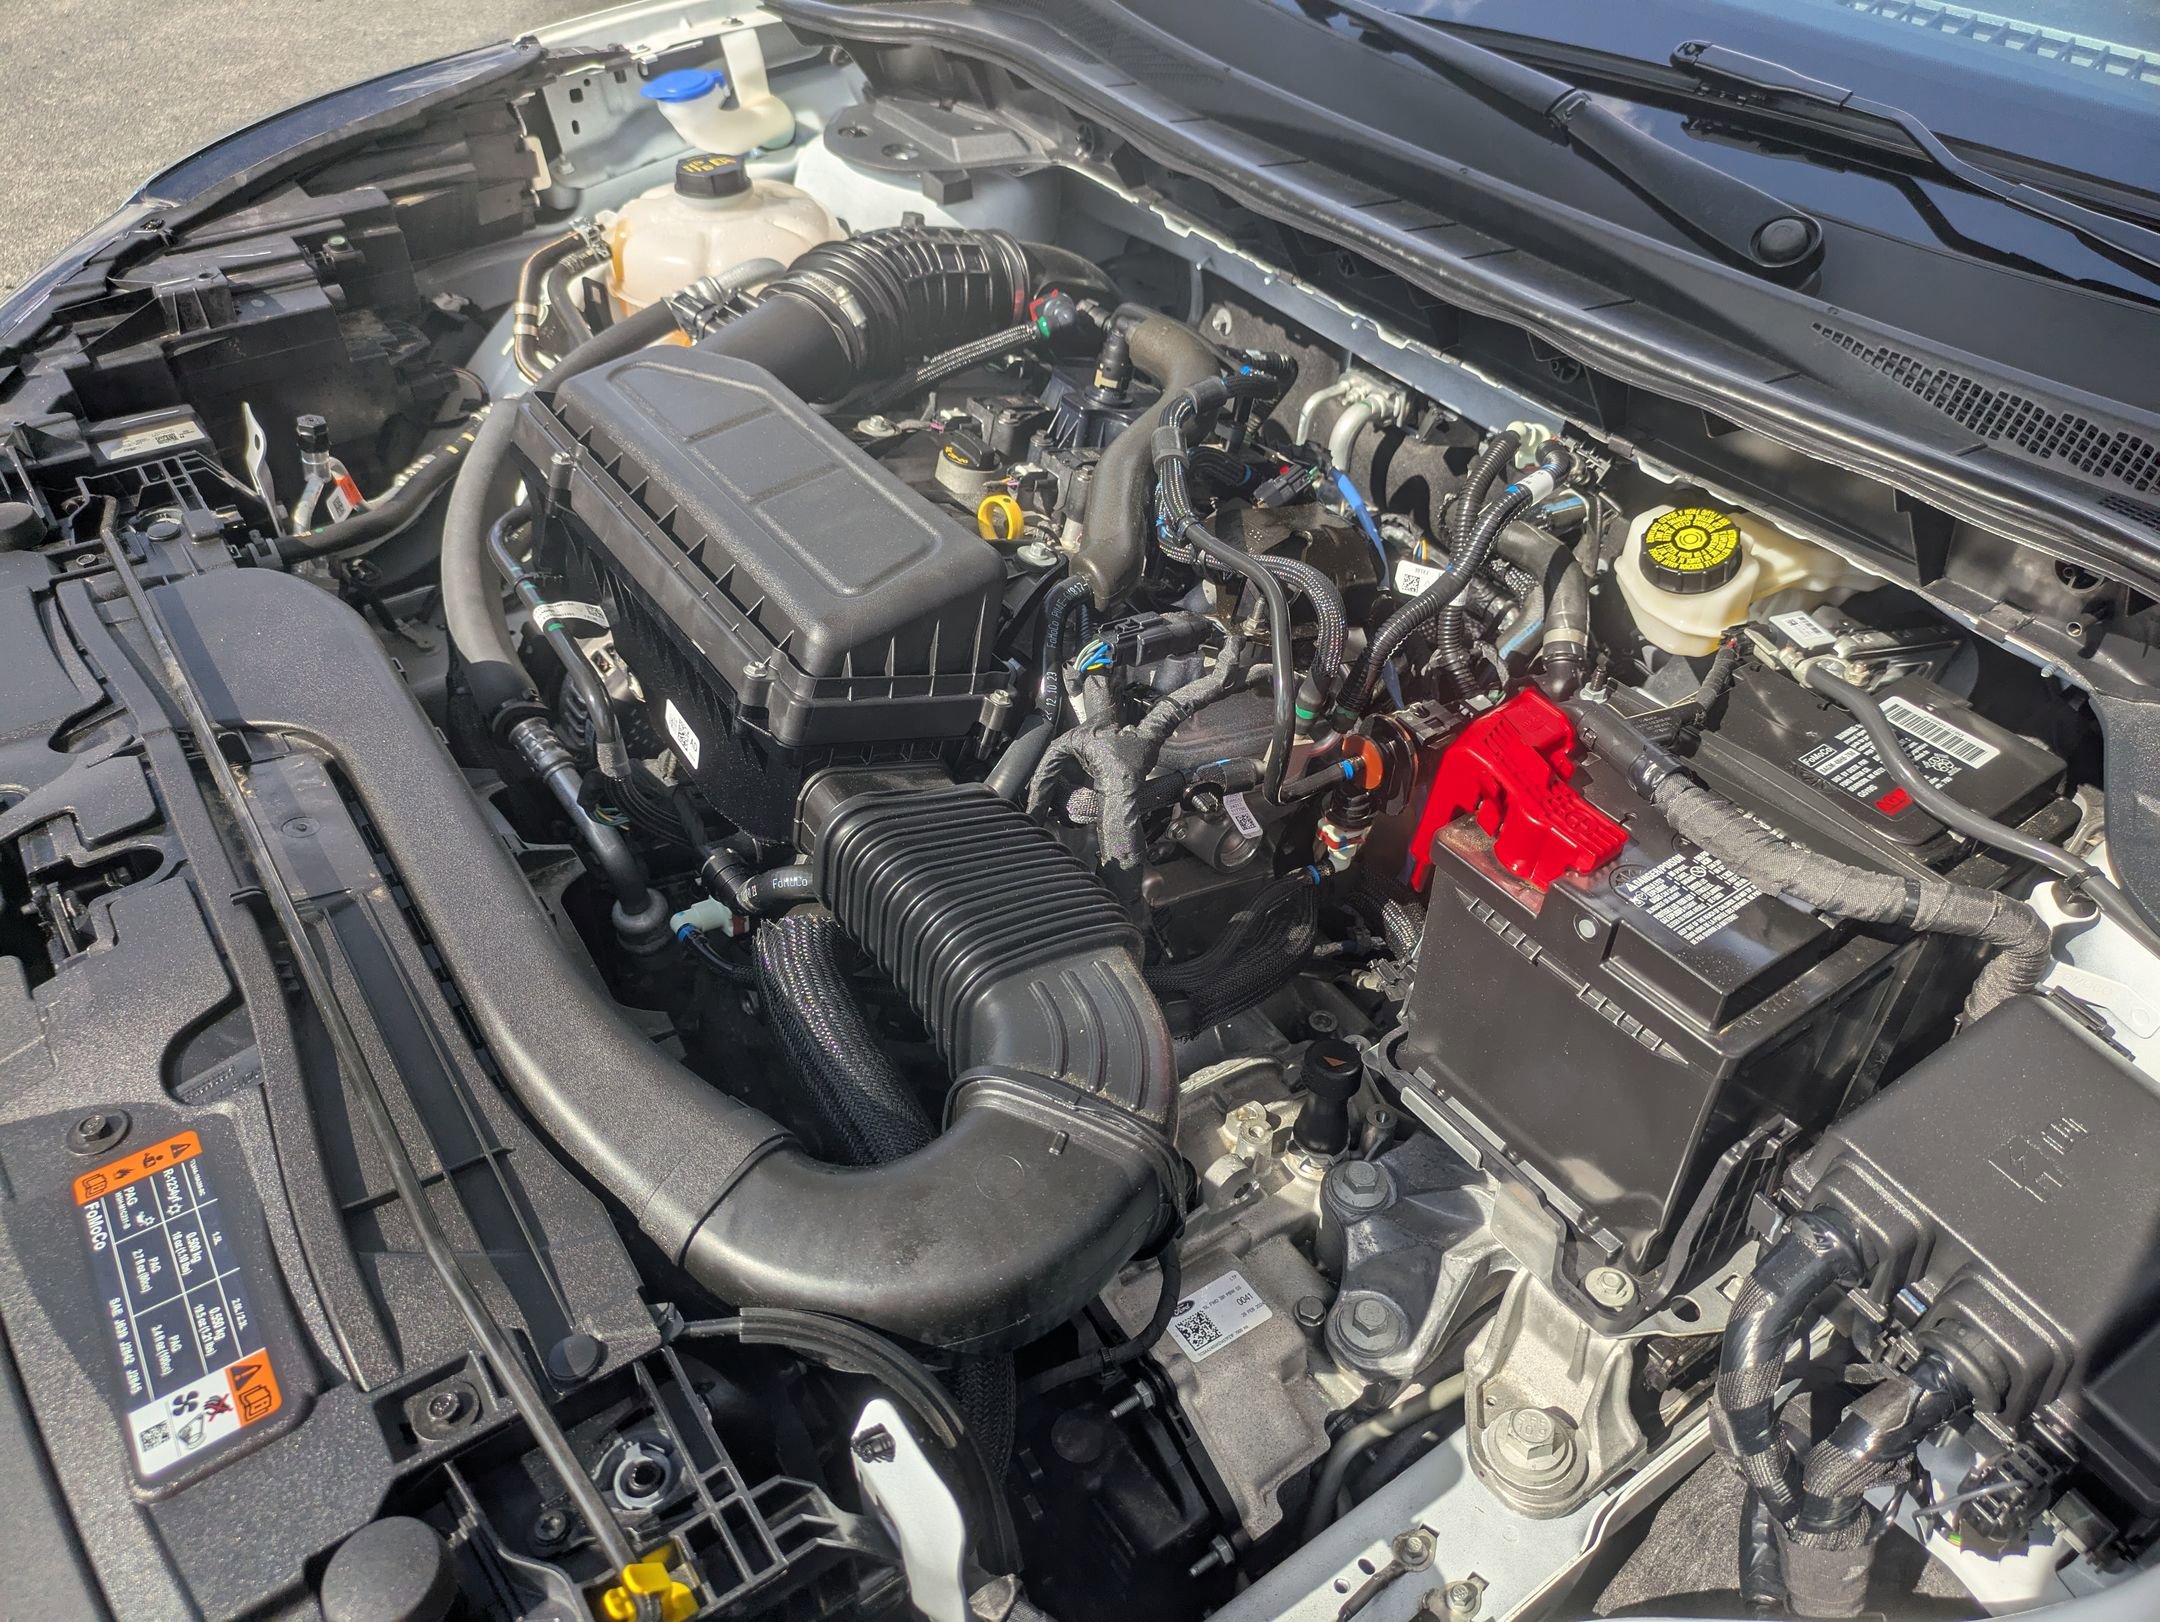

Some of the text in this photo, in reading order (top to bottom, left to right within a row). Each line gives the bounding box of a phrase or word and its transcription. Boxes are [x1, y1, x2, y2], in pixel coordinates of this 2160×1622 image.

[1047, 619, 1060, 648] FoMoCo
[1803, 747, 1832, 765] FoMoCo
[1632, 853, 1686, 887] DANGER/POISON
[162, 1167, 182, 1204] R-1234yf
[123, 1185, 138, 1207] PAG
[84, 1201, 107, 1251] FoMoCo
[173, 1238, 182, 1249] oz
[148, 1256, 162, 1274] PAG
[189, 1250, 204, 1264] kg
[135, 1263, 146, 1274] oz
[109, 1297, 124, 1317] SAE
[1236, 1292, 1254, 1305] 0041
[1173, 1302, 1191, 1316] Ford
[197, 1317, 206, 1327] oz
[208, 1305, 228, 1341] 0.550 kg
[154, 1340, 166, 1352] oz
[168, 1333, 182, 1353] PAG
